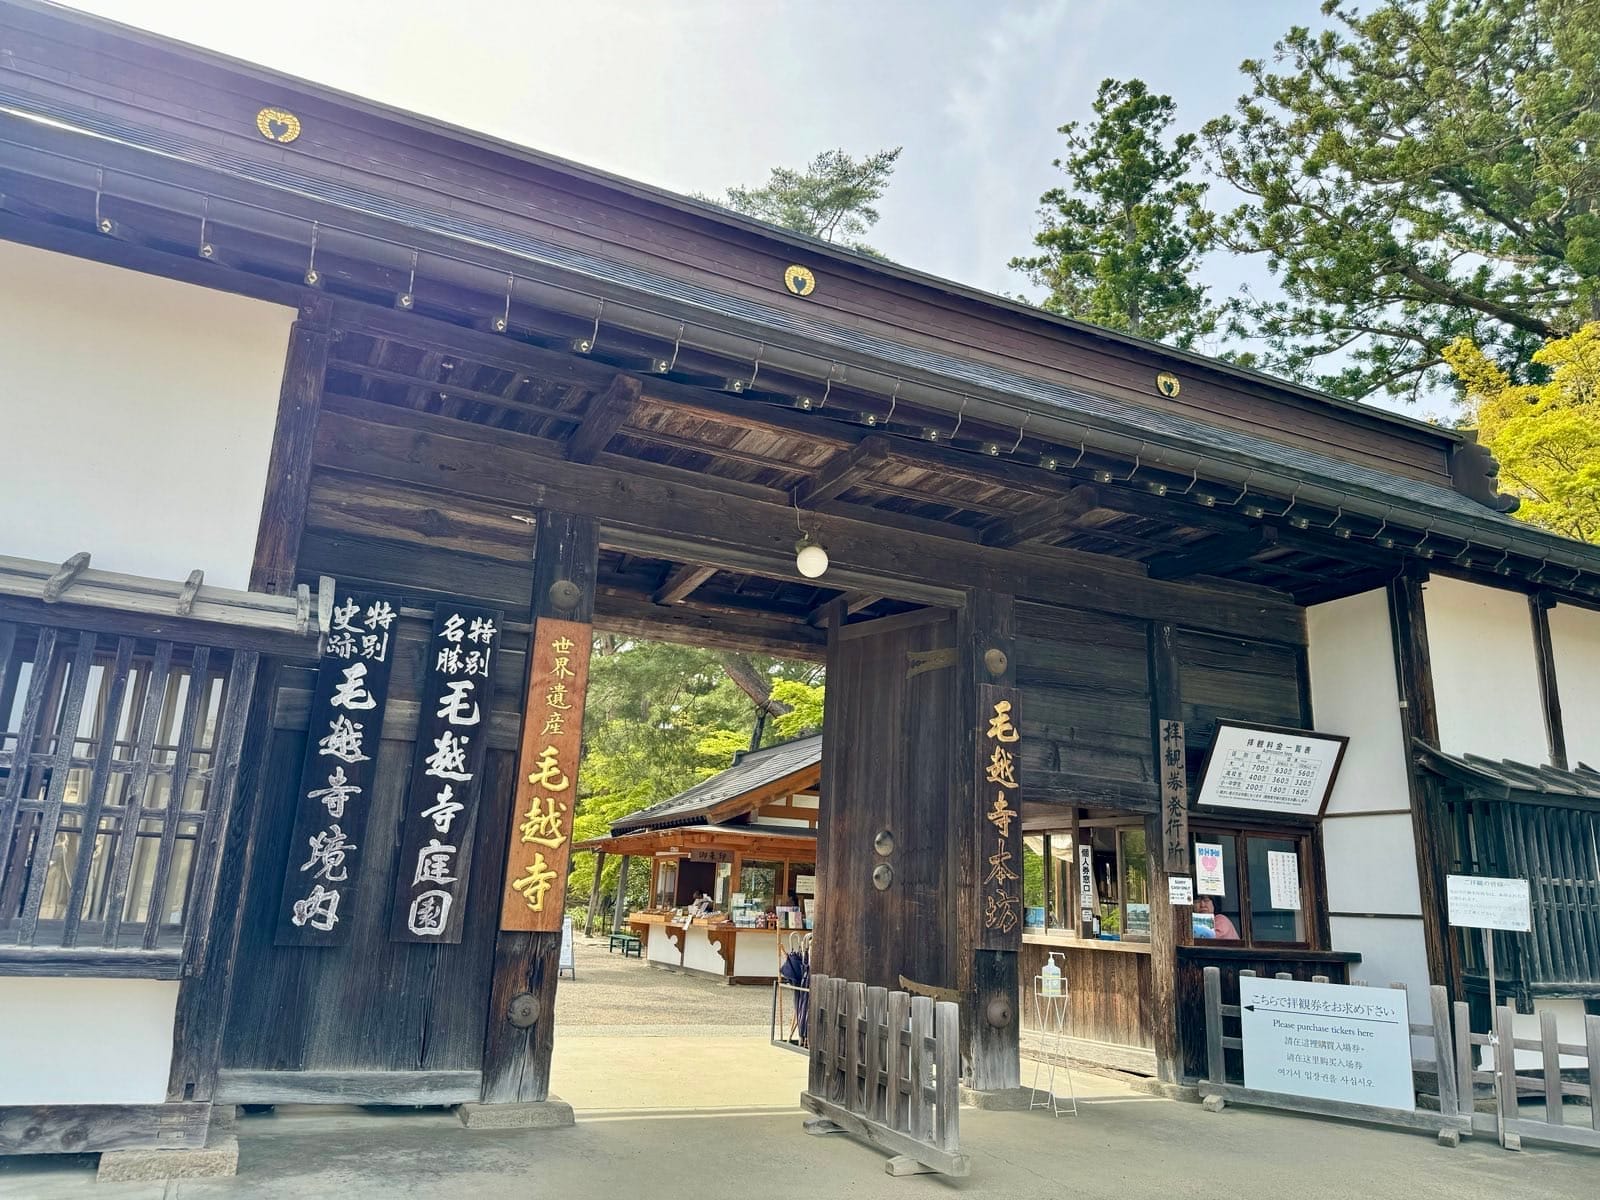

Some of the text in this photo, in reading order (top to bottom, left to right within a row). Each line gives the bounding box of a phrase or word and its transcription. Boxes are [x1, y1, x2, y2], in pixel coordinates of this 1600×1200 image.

[363, 600, 397, 662] 特別
[434, 613, 465, 674] 名勝
[465, 617, 497, 678] 特別
[539, 636, 575, 736] 世界遺産
[291, 662, 376, 932] 毛越寺境内
[407, 680, 481, 936] 毛越寺庭園
[984, 701, 1020, 934] 毛越寺本坊
[511, 745, 570, 913] 毛越寺
[1080, 848, 1092, 892] 個人券窓口
[1251, 994, 1396, 1017] こちらで拝観券をお求め下さい
[1273, 1019, 1375, 1038] Please purchase tickets here
[1277, 1067, 1301, 1079] 여기서
[1304, 1071, 1337, 1084] 입장권을
